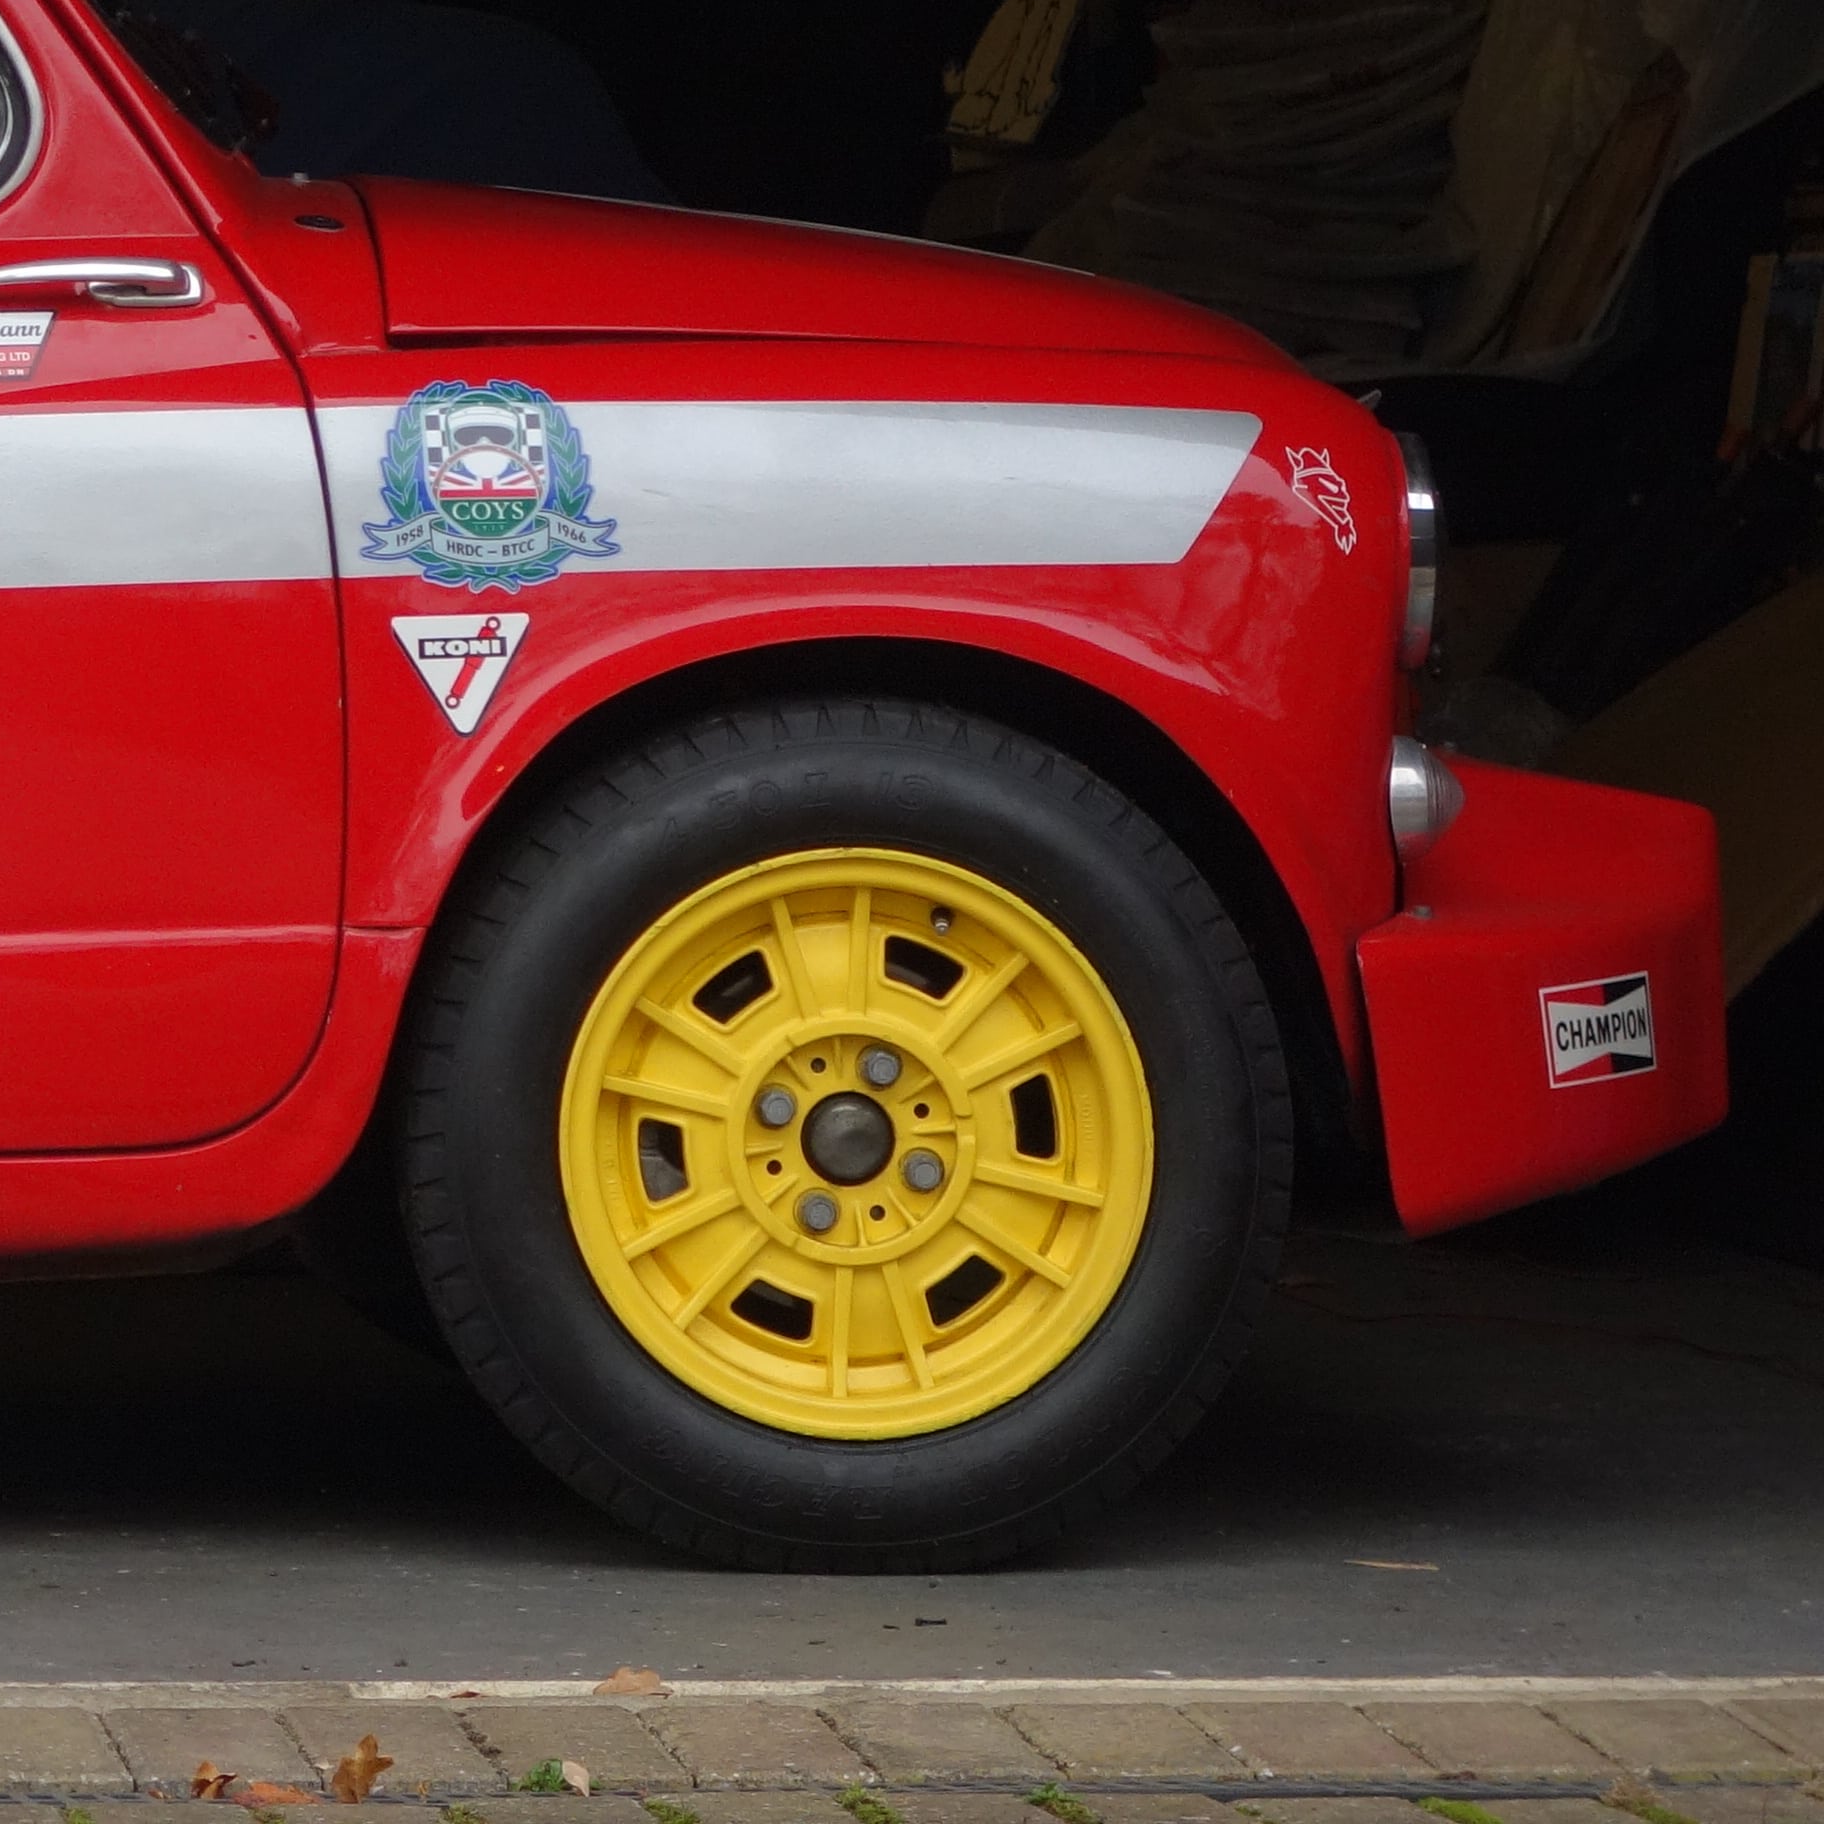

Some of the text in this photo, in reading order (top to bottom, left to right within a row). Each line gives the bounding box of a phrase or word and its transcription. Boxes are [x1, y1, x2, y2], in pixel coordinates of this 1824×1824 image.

[9, 350, 31, 362] LTD
[452, 500, 526, 522] COYS
[395, 525, 426, 548] 1958
[446, 538, 484, 558] HRDC
[502, 537, 535, 557] BTCC
[556, 523, 587, 545] 1966
[423, 638, 502, 657] KONI
[1555, 1007, 1649, 1052] CHAMPION
